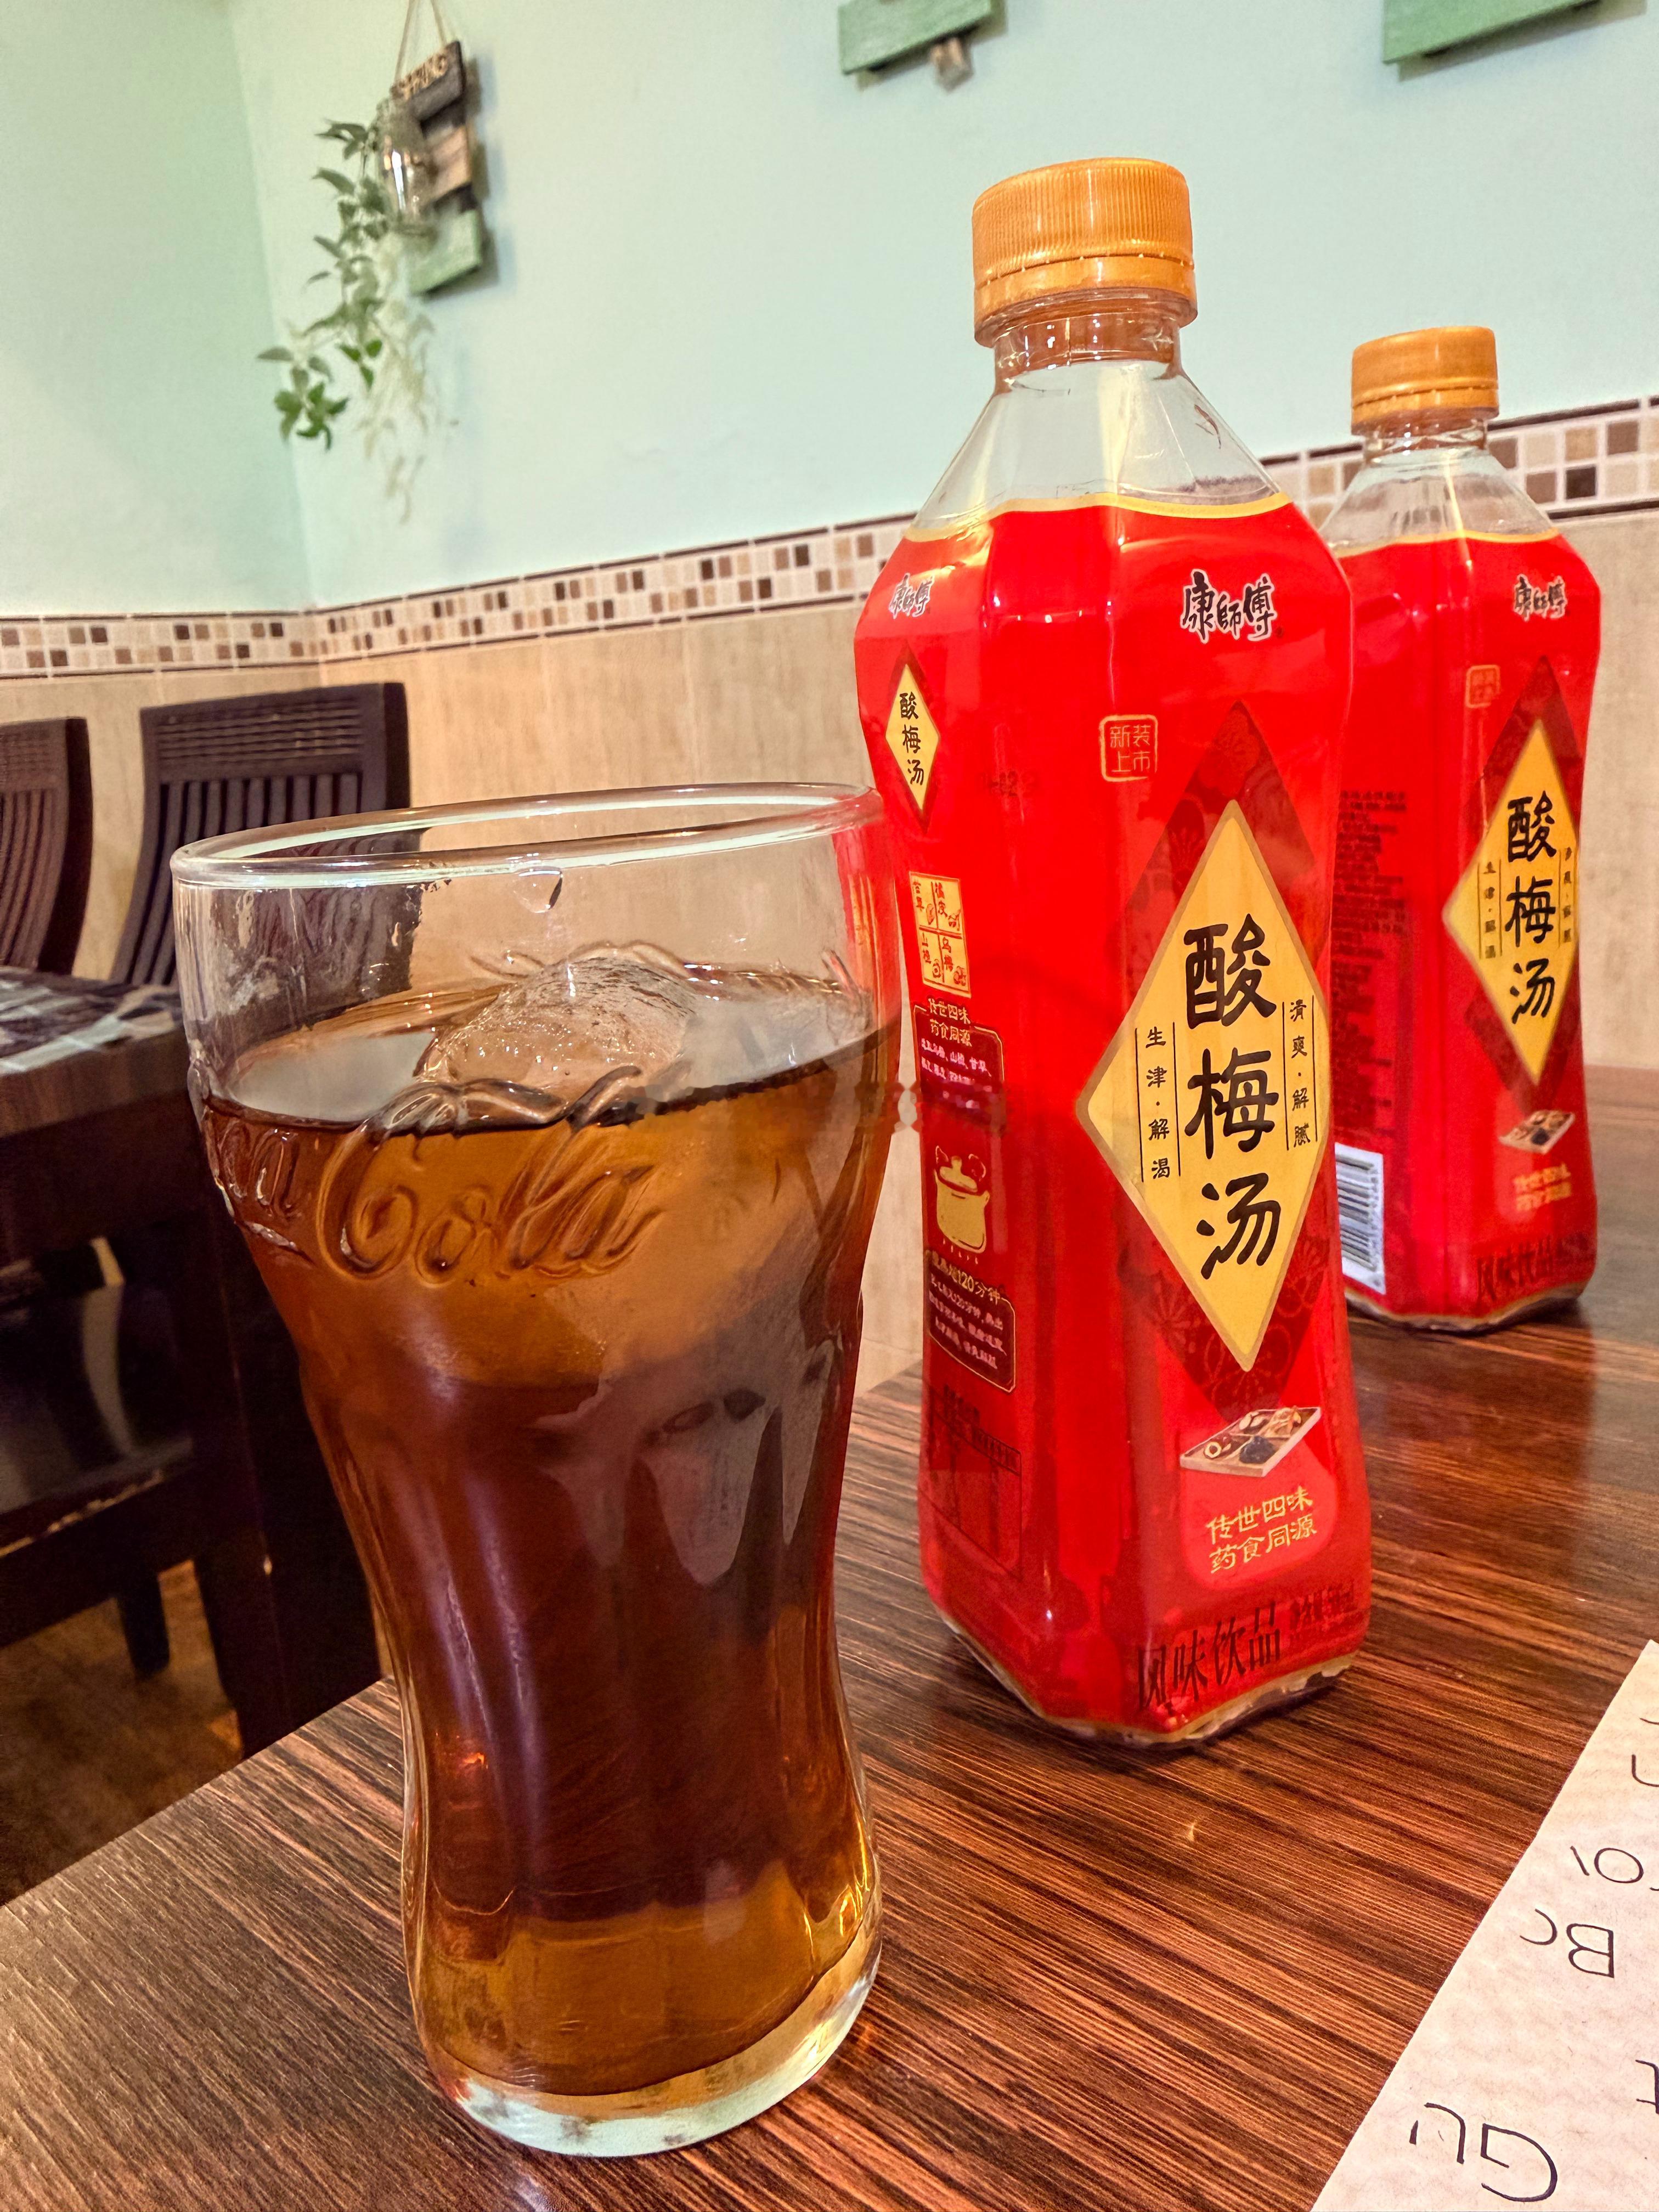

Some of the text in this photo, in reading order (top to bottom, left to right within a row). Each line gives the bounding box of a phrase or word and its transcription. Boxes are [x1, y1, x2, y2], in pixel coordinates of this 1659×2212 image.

[899, 691, 924, 786] 酸梅汤
[1505, 790, 1558, 1025] 酸梅汤
[1183, 912, 1281, 1280] 酸梅汤
[1205, 1485, 1313, 1545] 传世四味
[1208, 1516, 1318, 1574] 药食同源
[1138, 1603, 1281, 1708] 风味饮品
